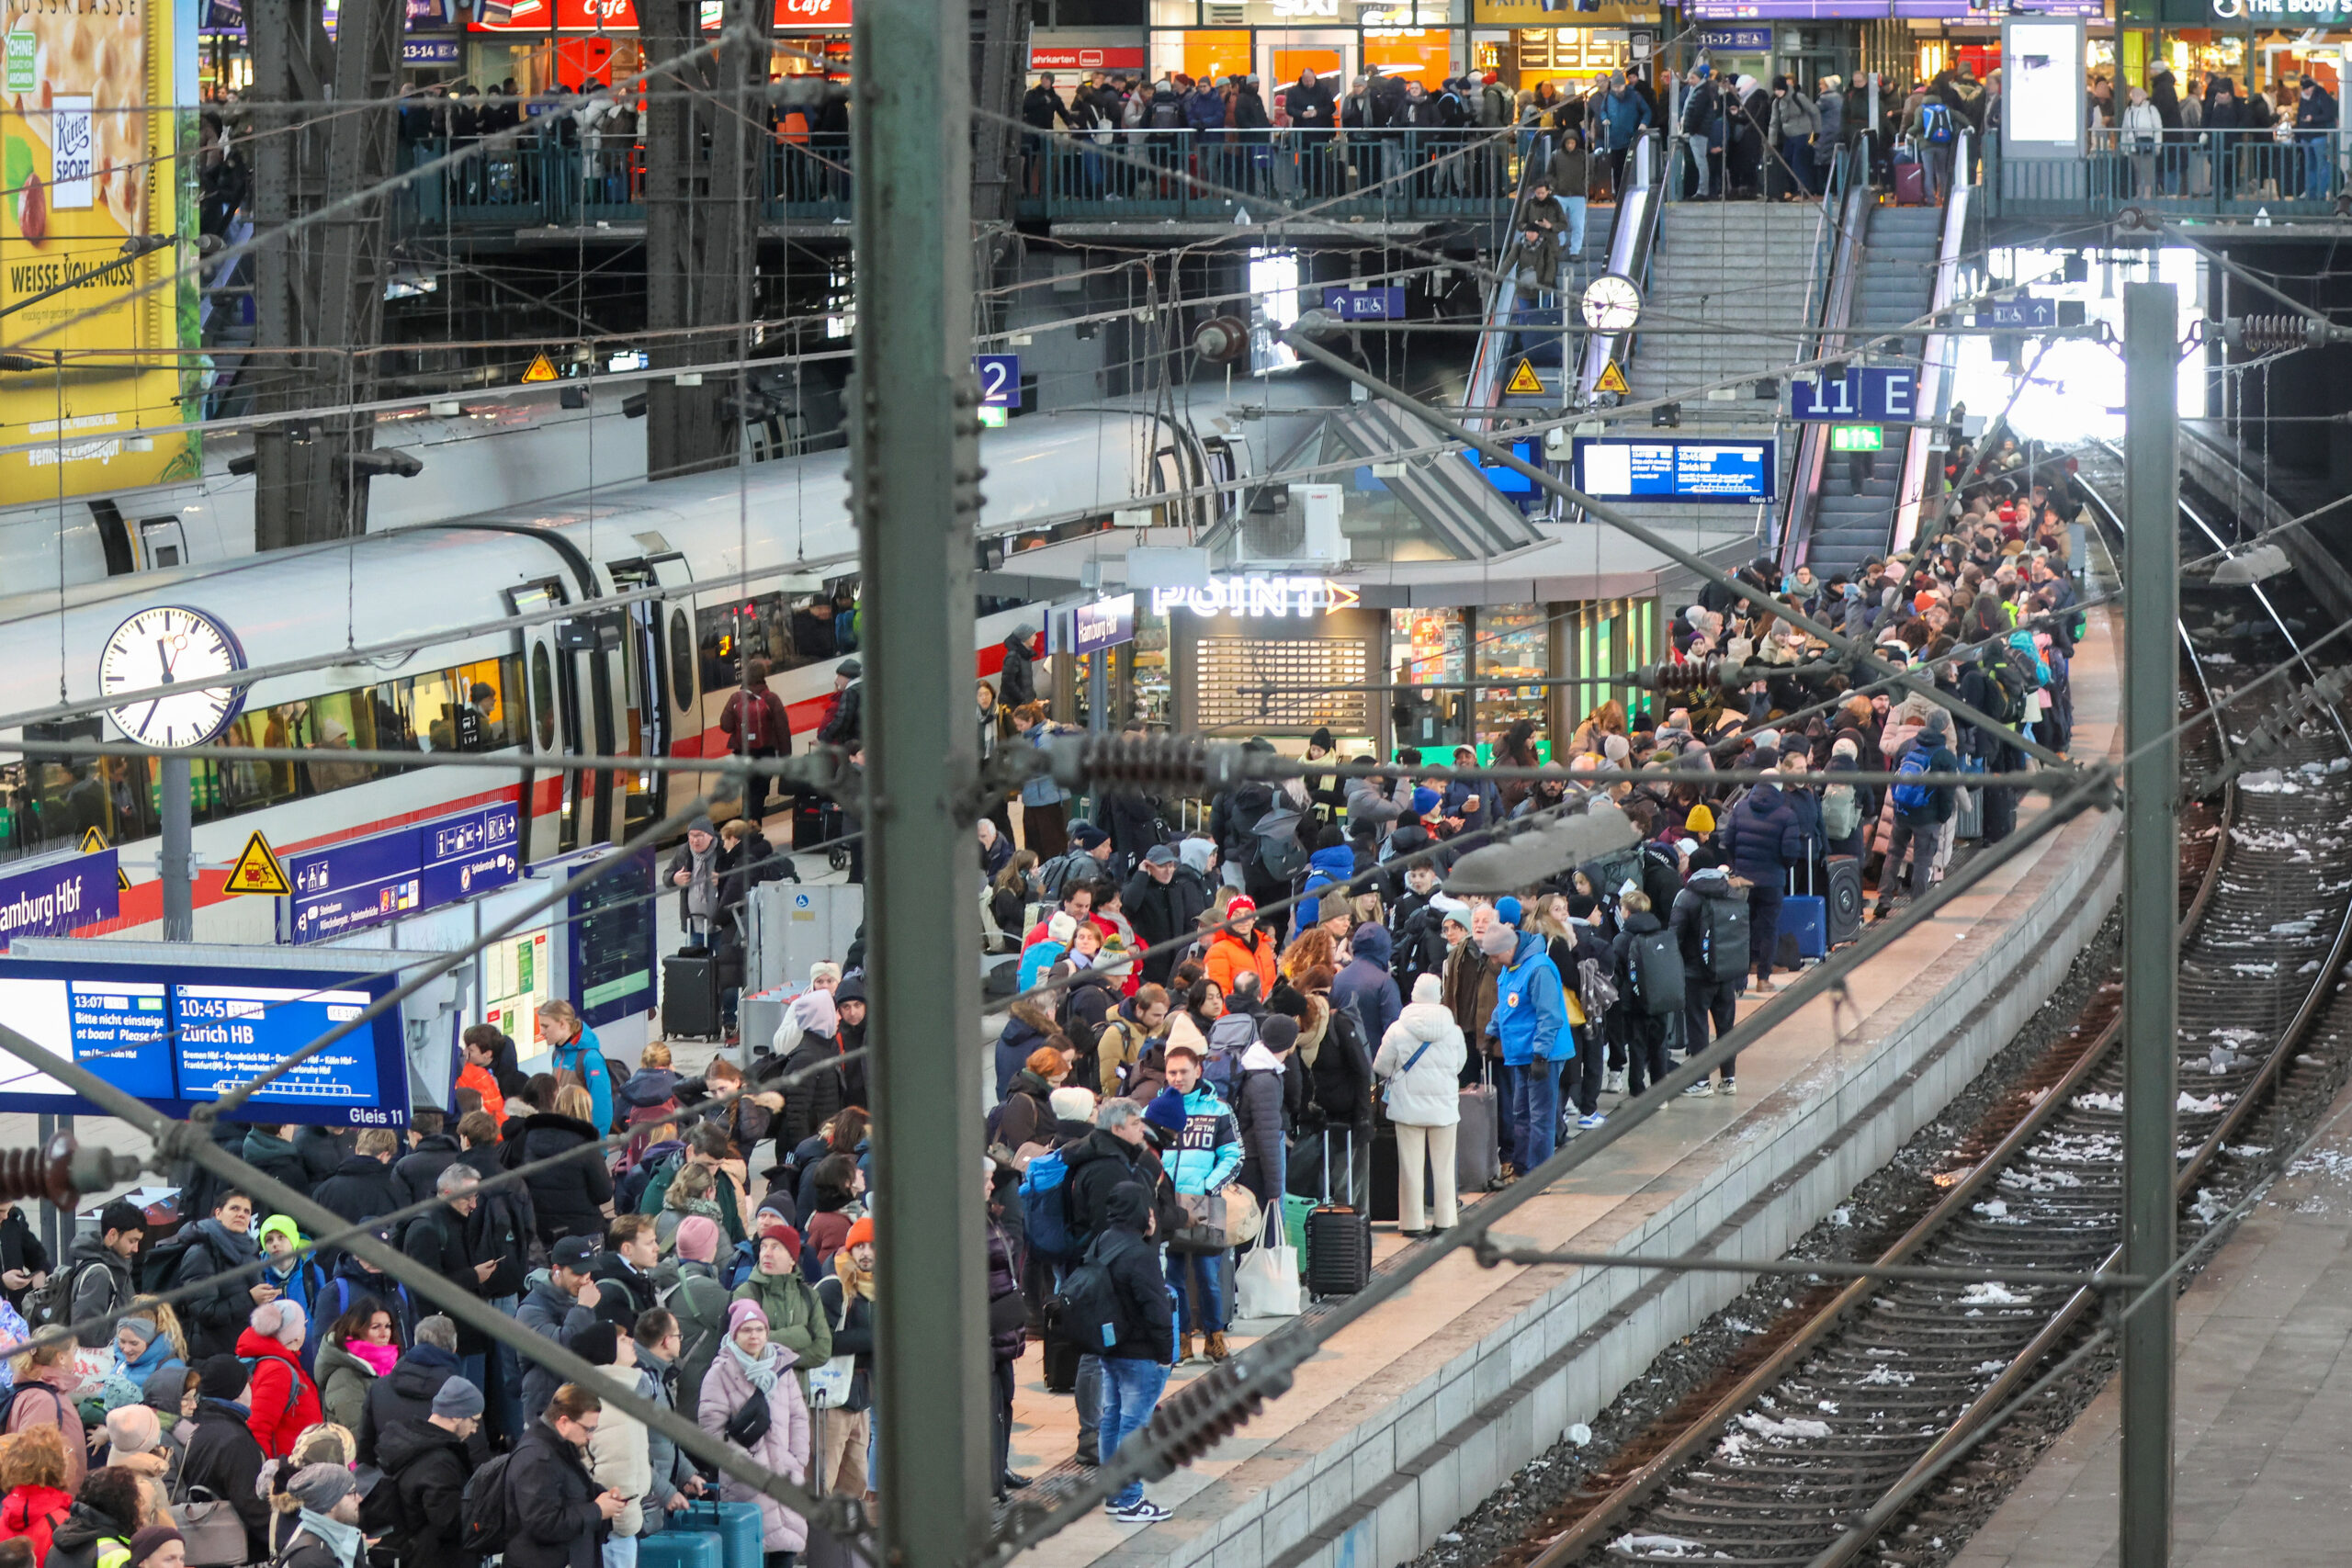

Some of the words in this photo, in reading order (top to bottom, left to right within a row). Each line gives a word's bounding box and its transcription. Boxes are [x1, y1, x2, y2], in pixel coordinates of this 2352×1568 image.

[2250, 0, 2283, 12] THE
[2288, 0, 2335, 13] BODY
[9, 39, 33, 57] OHNE
[402, 46, 435, 57] 13-14
[57, 111, 89, 155] Ritter
[57, 159, 90, 182] SPORT
[11, 264, 59, 293] WEISSE
[64, 260, 133, 289] VOLL-NUSS
[983, 362, 1007, 400] 2
[1807, 375, 1853, 412] 11
[1885, 376, 1910, 414] E
[1749, 495, 1766, 503] Gleis
[1152, 576, 1323, 617] POINT
[1078, 617, 1106, 645] Hamburg
[56, 875, 82, 916] Hbf
[74, 995, 103, 1008] 13:07
[179, 999, 226, 1018] 10:45
[75, 1011, 97, 1024] Bitte
[98, 1013, 122, 1026] nicht
[87, 1028, 115, 1041] board
[119, 1029, 150, 1042] Please
[151, 1030, 164, 1042] do
[180, 1023, 228, 1043] Zürich
[231, 1025, 254, 1043] HB
[183, 1050, 207, 1059] Bremen
[208, 1051, 220, 1060] Hbf
[224, 1051, 257, 1061] Osnabrück
[258, 1053, 270, 1062] Hbf
[324, 1055, 340, 1065] Köln
[340, 1056, 352, 1065] Hbf
[319, 1066, 331, 1075] Hbf
[350, 1108, 387, 1124] Gleis
[391, 1110, 403, 1124] 11
